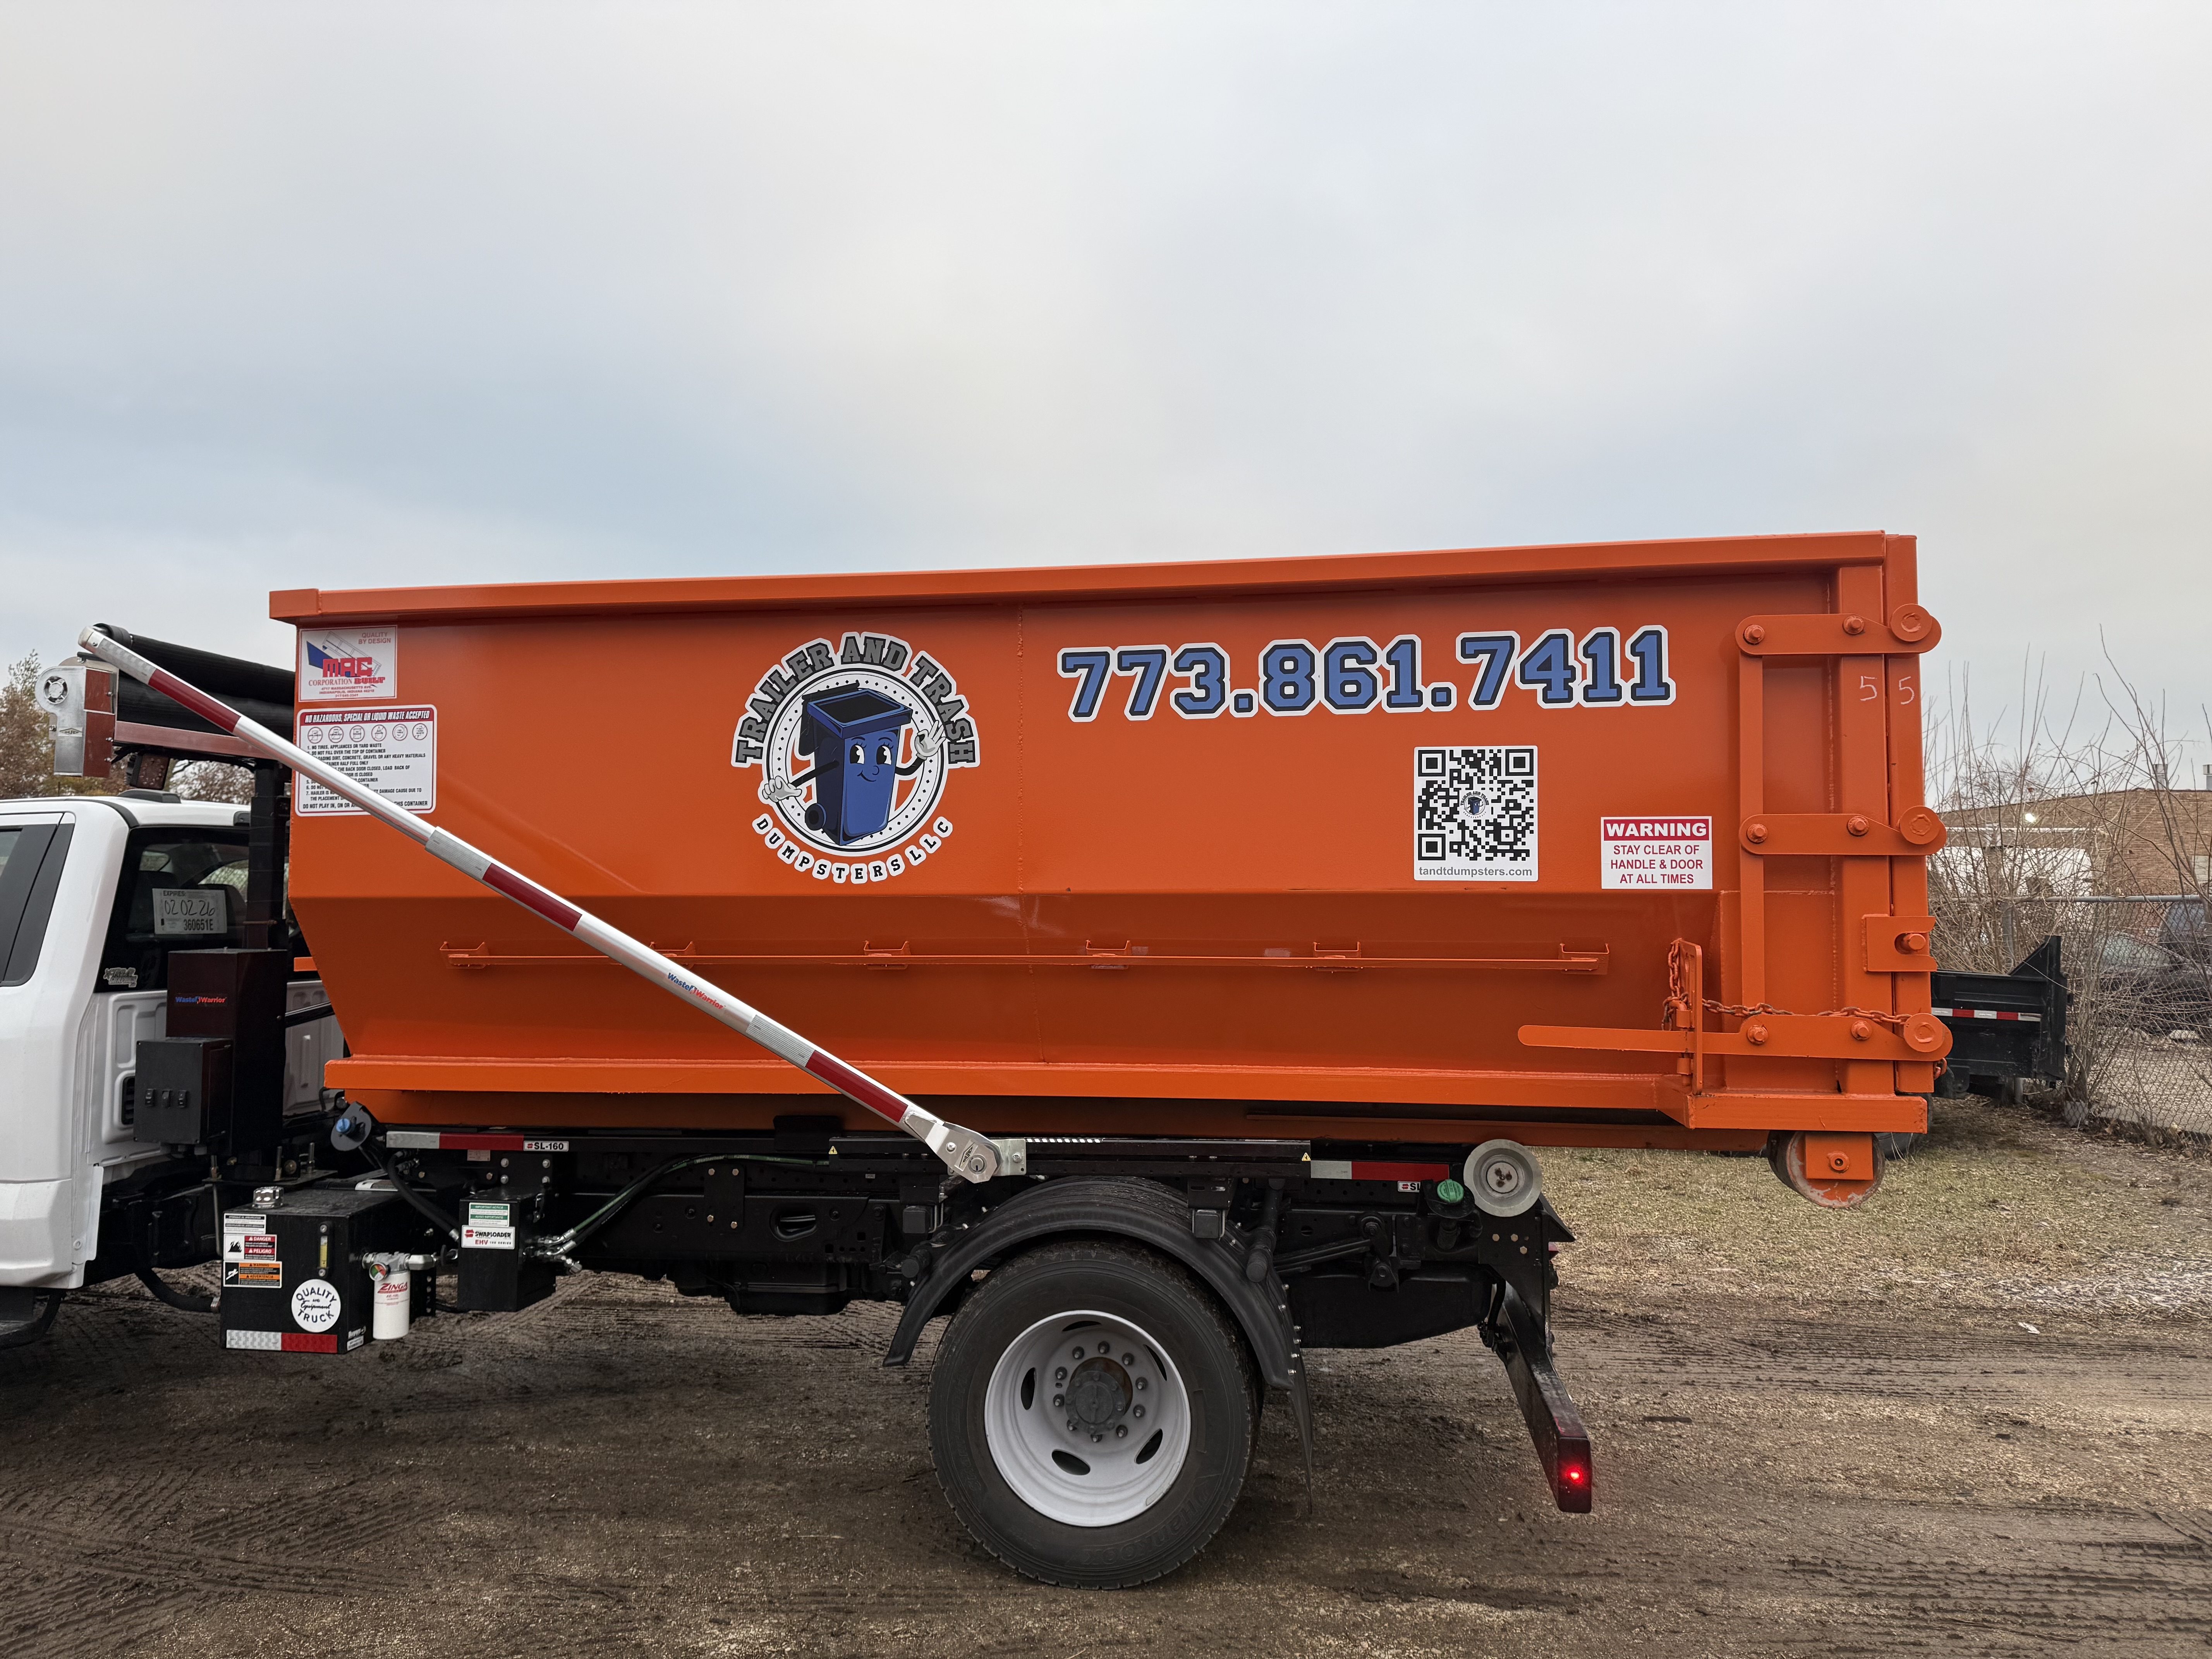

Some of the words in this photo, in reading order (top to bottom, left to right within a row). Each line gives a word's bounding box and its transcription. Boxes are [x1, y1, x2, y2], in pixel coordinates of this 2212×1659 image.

[323, 657, 372, 678] MAC
[1061, 628, 1672, 720] 773.861.7411
[735, 642, 834, 763] TRAILER
[841, 636, 908, 672] AND
[909, 655, 976, 764] TRASH
[305, 715, 313, 723] NO
[313, 714, 342, 723] HAZARDOUS,
[343, 713, 363, 721] SPECIAL
[364, 713, 371, 721] OR
[371, 712, 387, 721] LIQUID
[388, 711, 405, 720] WASTE
[405, 711, 430, 720] ACCEPTED
[1606, 823, 1707, 837] WARNING
[757, 818, 902, 879] DUMPSTERS
[908, 821, 949, 861] LLC
[1614, 845, 1641, 855] STAY
[1644, 845, 1681, 855] CLEAR
[1685, 845, 1699, 855] OF
[1611, 859, 1657, 870] HANDLE
[1659, 859, 1667, 870] &
[1670, 859, 1704, 870] DOOR
[1419, 866, 1532, 878] tandtdumpsters.com
[1620, 873, 1633, 884] AT
[1636, 873, 1657, 884] ALL
[1660, 873, 1694, 884] TIMES
[184, 919, 213, 931] 360651E
[379, 1281, 407, 1291] ZINGA
[296, 1287, 337, 1302] QUALITY
[298, 1309, 334, 1322] TRUCK
